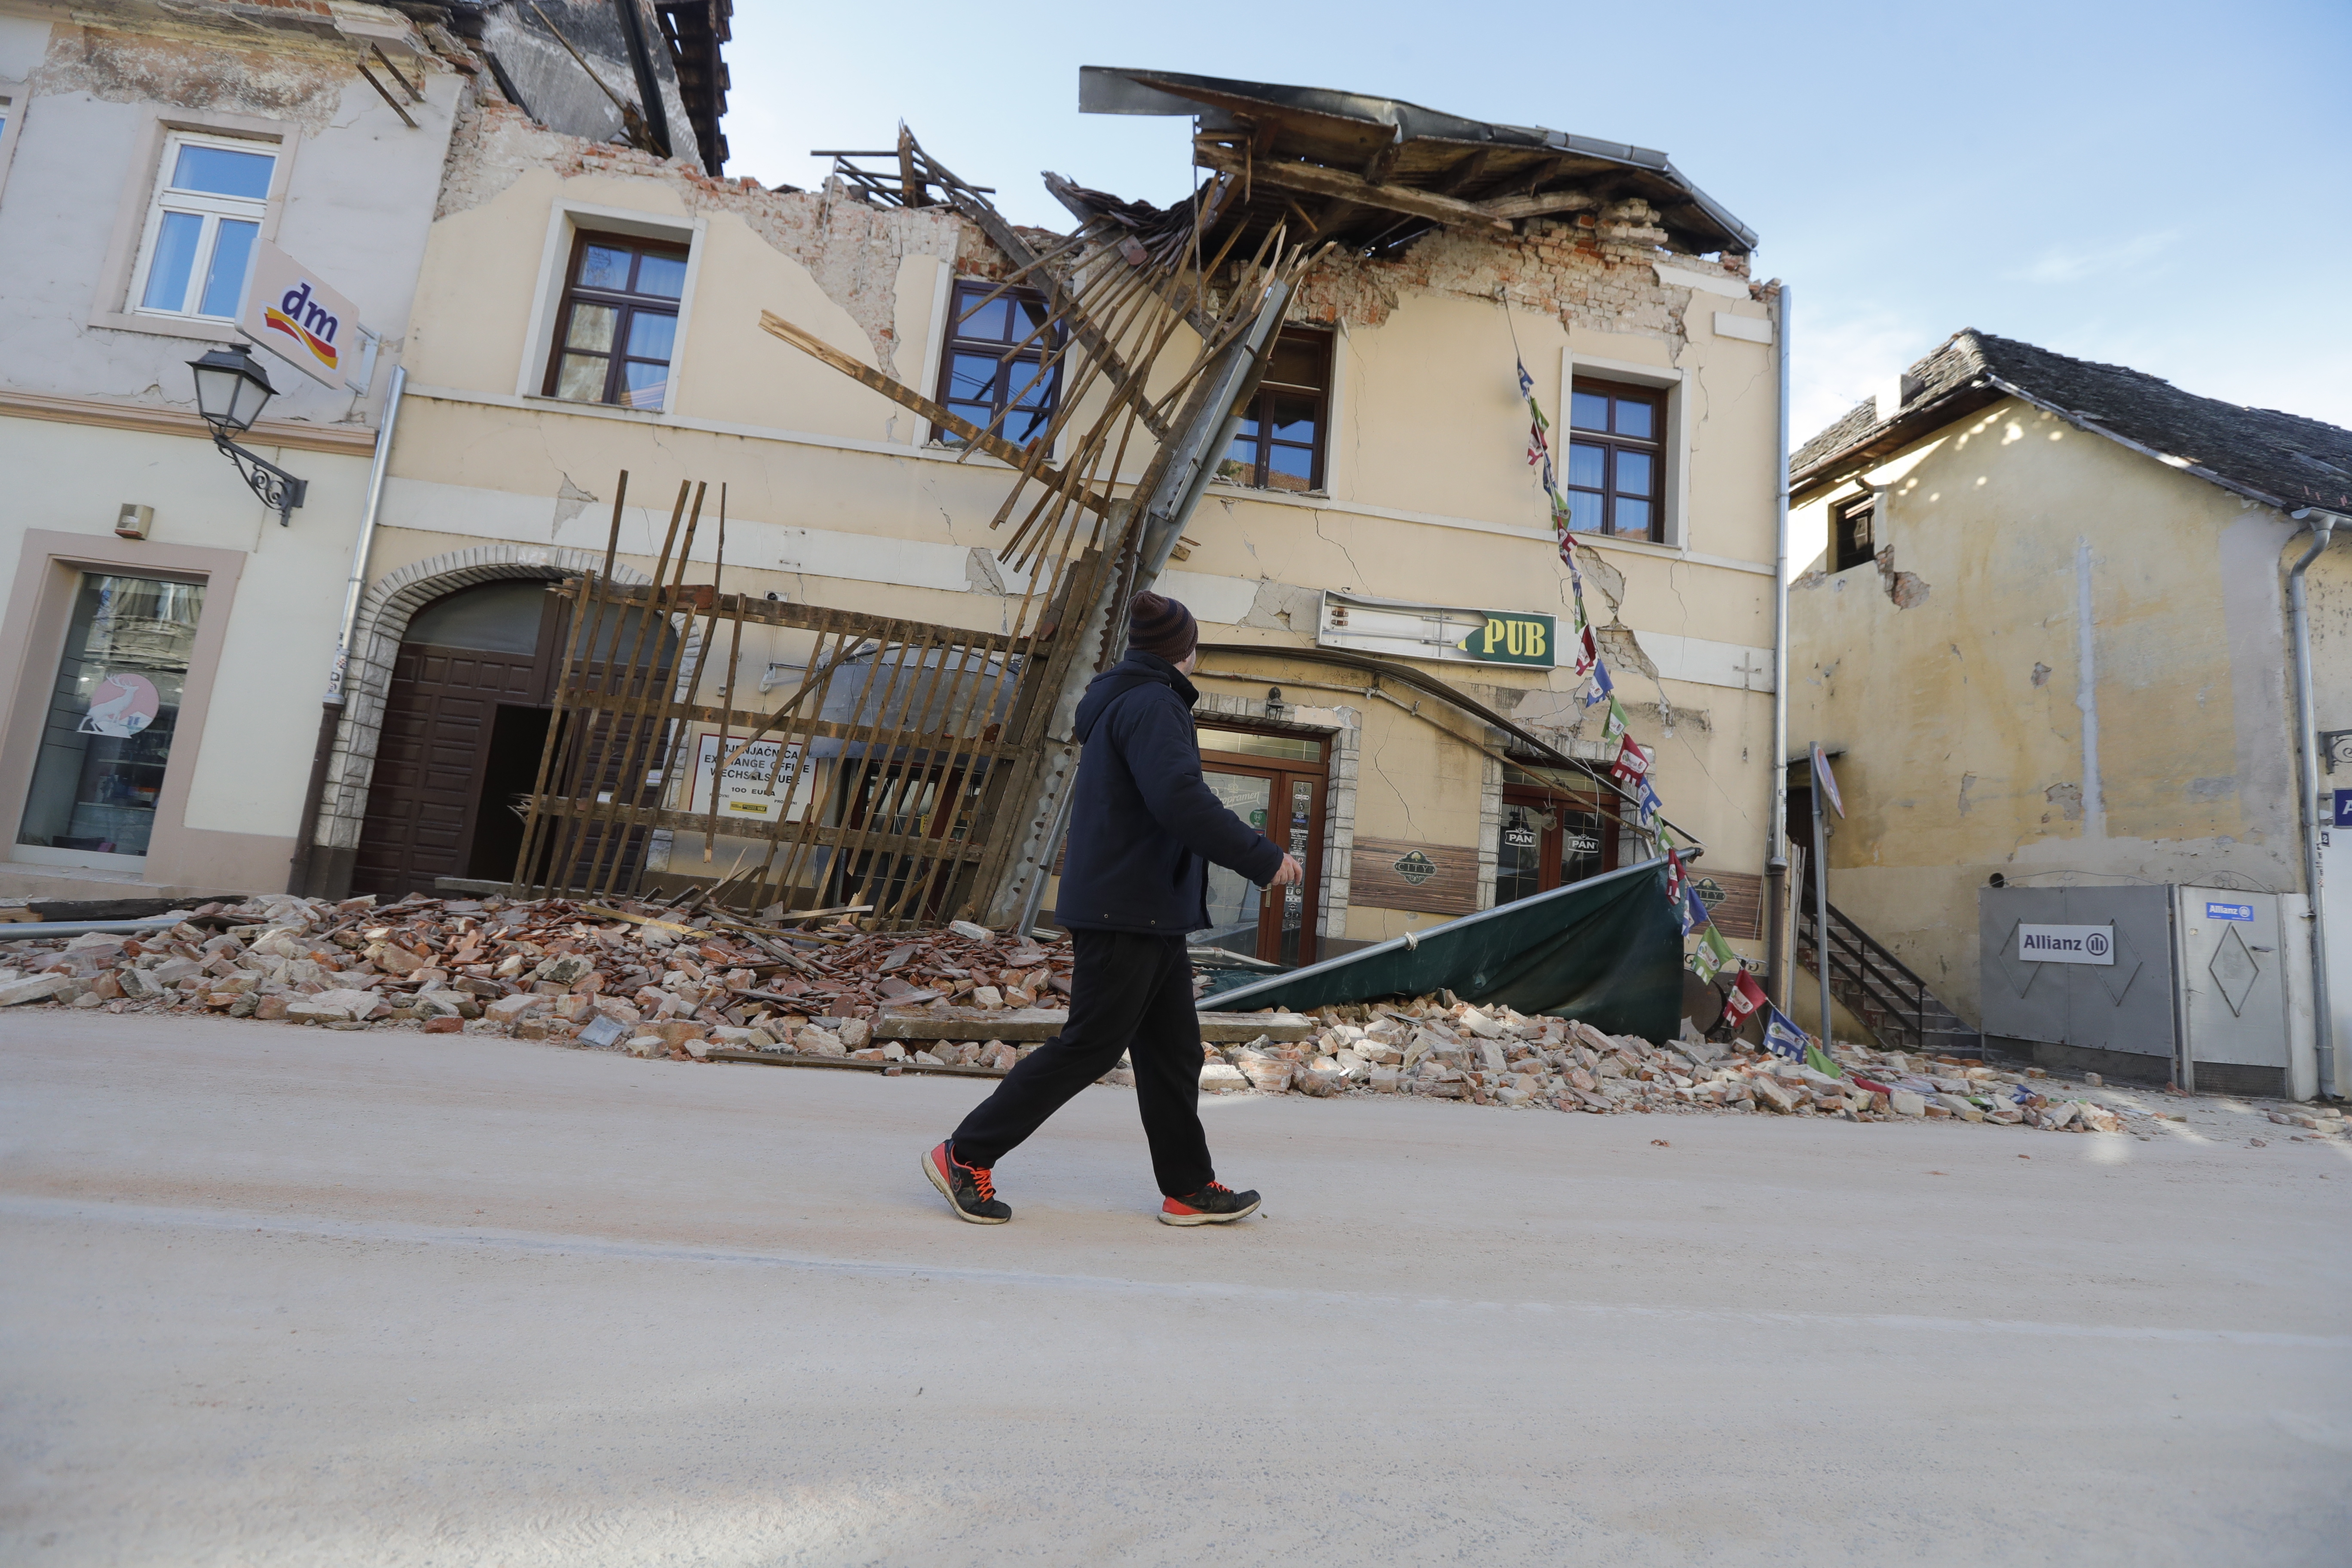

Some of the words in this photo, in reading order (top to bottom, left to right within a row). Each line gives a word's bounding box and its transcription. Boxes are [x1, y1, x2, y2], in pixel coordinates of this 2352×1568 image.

[282, 282, 338, 343] dm
[1483, 619, 1546, 657] PUB
[724, 744, 798, 759] JNJAČNCA
[704, 755, 765, 769] EXANGE
[770, 762, 810, 773] OFFIE
[1210, 787, 1260, 805] ropramen
[1509, 834, 1532, 843] PAN
[1572, 840, 1595, 849] PAN
[1398, 864, 1428, 873] CITY
[1700, 891, 1718, 899] ITY
[2209, 905, 2239, 915] Allianz
[2023, 934, 2082, 951] Allianz
